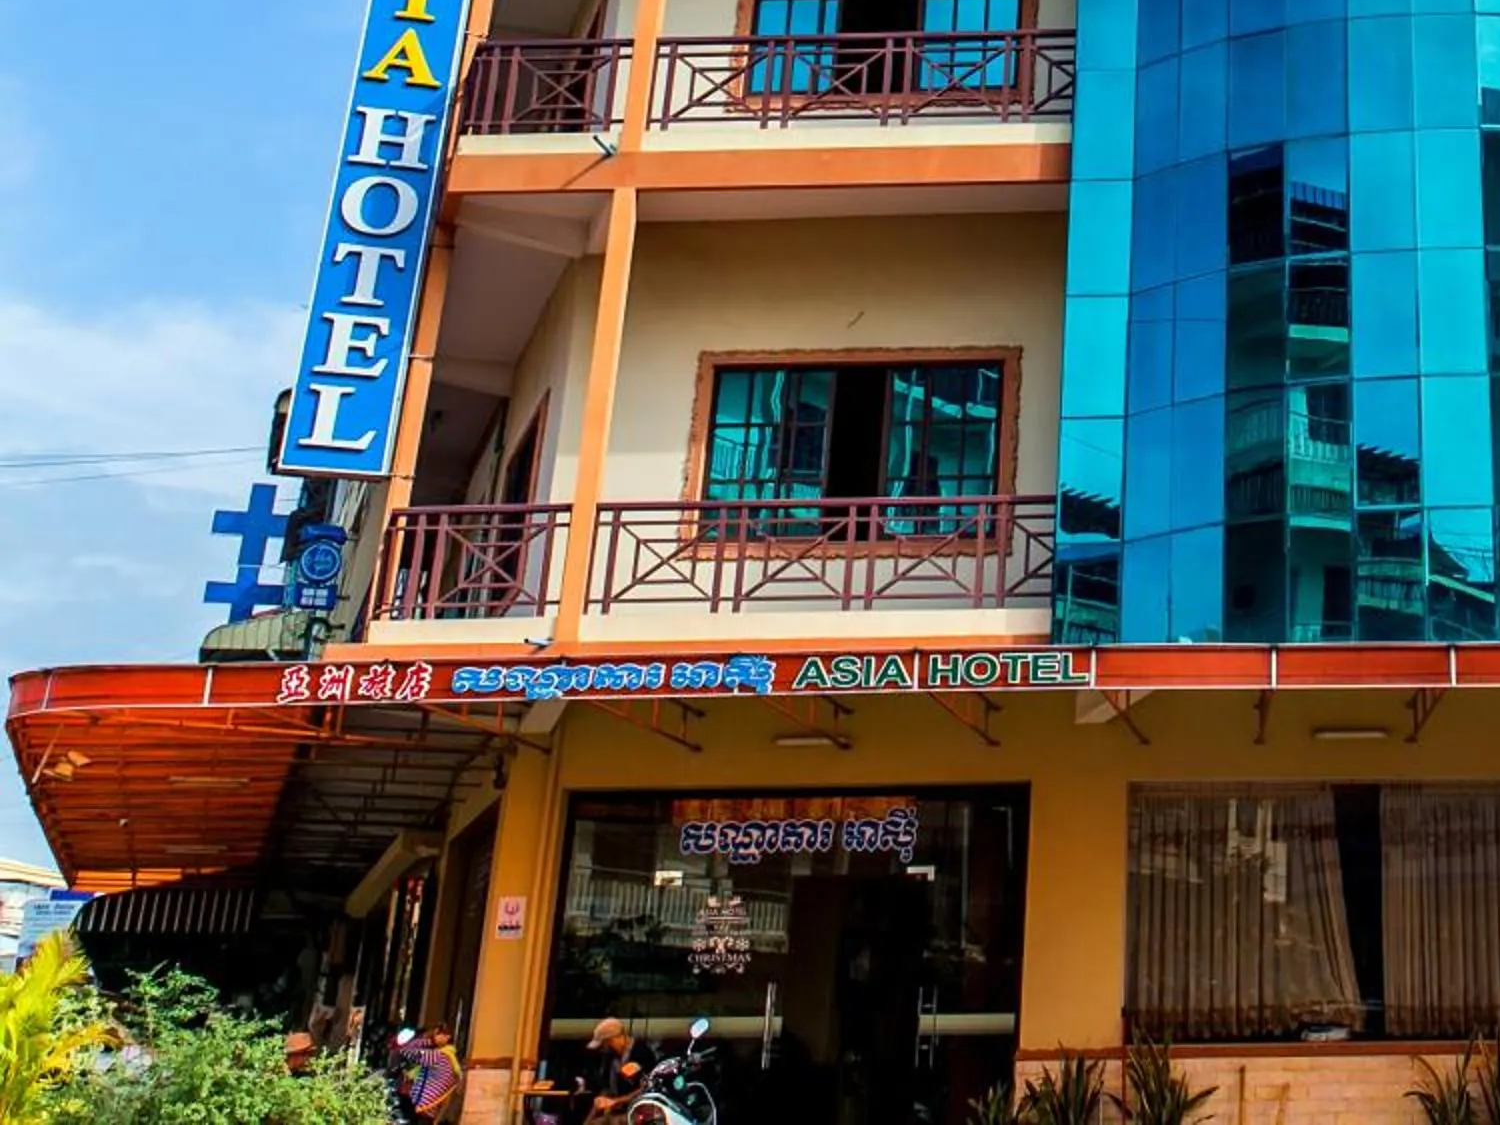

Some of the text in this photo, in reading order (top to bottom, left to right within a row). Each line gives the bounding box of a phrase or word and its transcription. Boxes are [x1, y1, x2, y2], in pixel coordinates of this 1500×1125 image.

[298, 104, 438, 452] HOTEL
[792, 651, 1090, 689] ASIA HOTEL
[687, 952, 751, 963] CHRISTMAS
